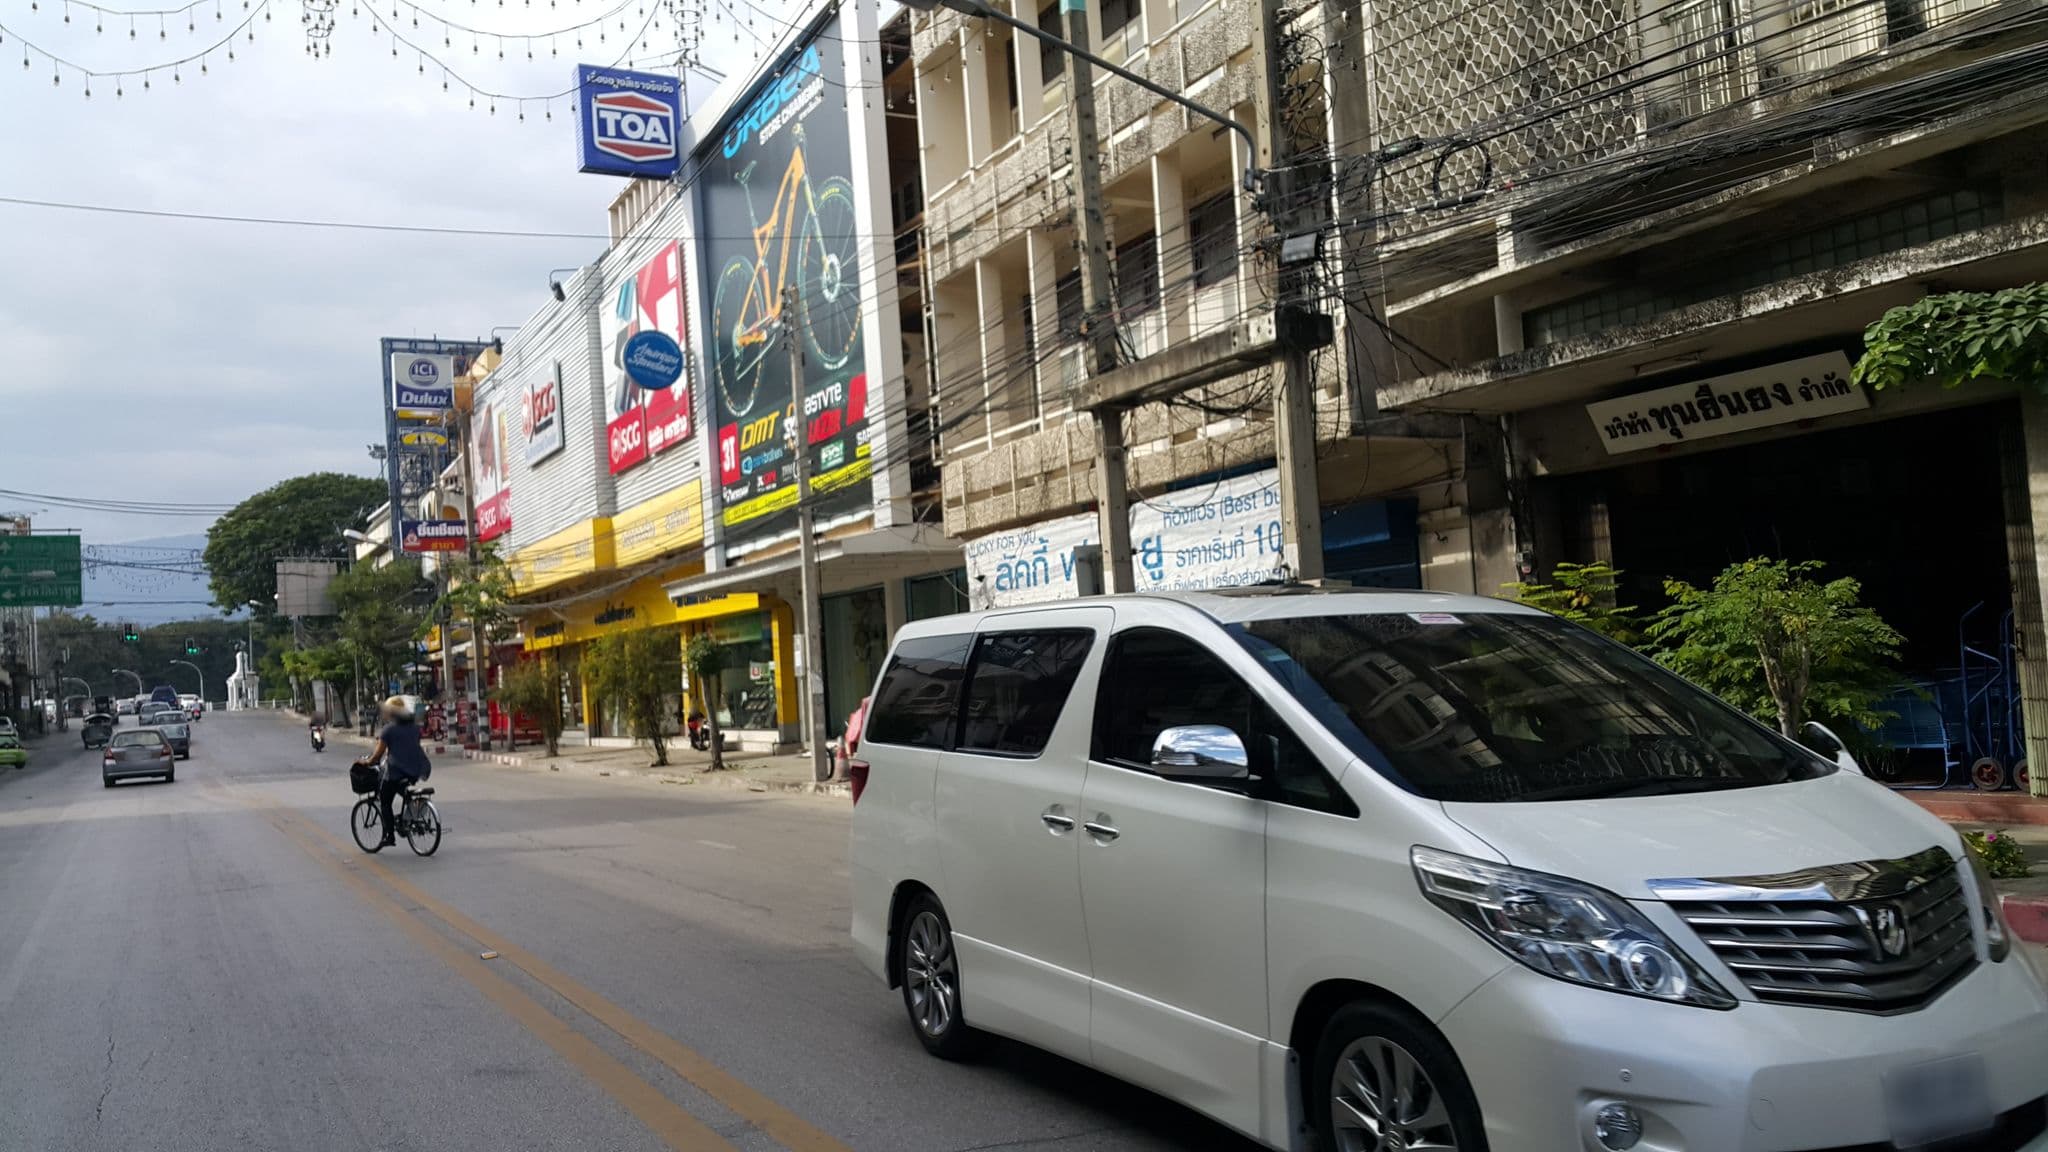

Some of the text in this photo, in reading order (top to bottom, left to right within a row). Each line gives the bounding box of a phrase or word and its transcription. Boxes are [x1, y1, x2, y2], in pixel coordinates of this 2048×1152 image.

[599, 110, 669, 143] TOA
[414, 363, 433, 376] ICI
[401, 391, 448, 405] Dulux
[535, 381, 556, 422] SCG
[1604, 411, 1653, 439] บริษัท
[1798, 371, 1852, 403] จำกัด
[621, 420, 641, 454] SCG
[740, 410, 781, 451] DMT
[722, 436, 736, 472] 3T
[485, 506, 497, 529] SCG
[1220, 494, 1257, 523] (Best
[968, 529, 1036, 559] LUCKY FOR YOU
[1141, 534, 1164, 581] ยู
[995, 536, 1050, 592] ลัคกี้
